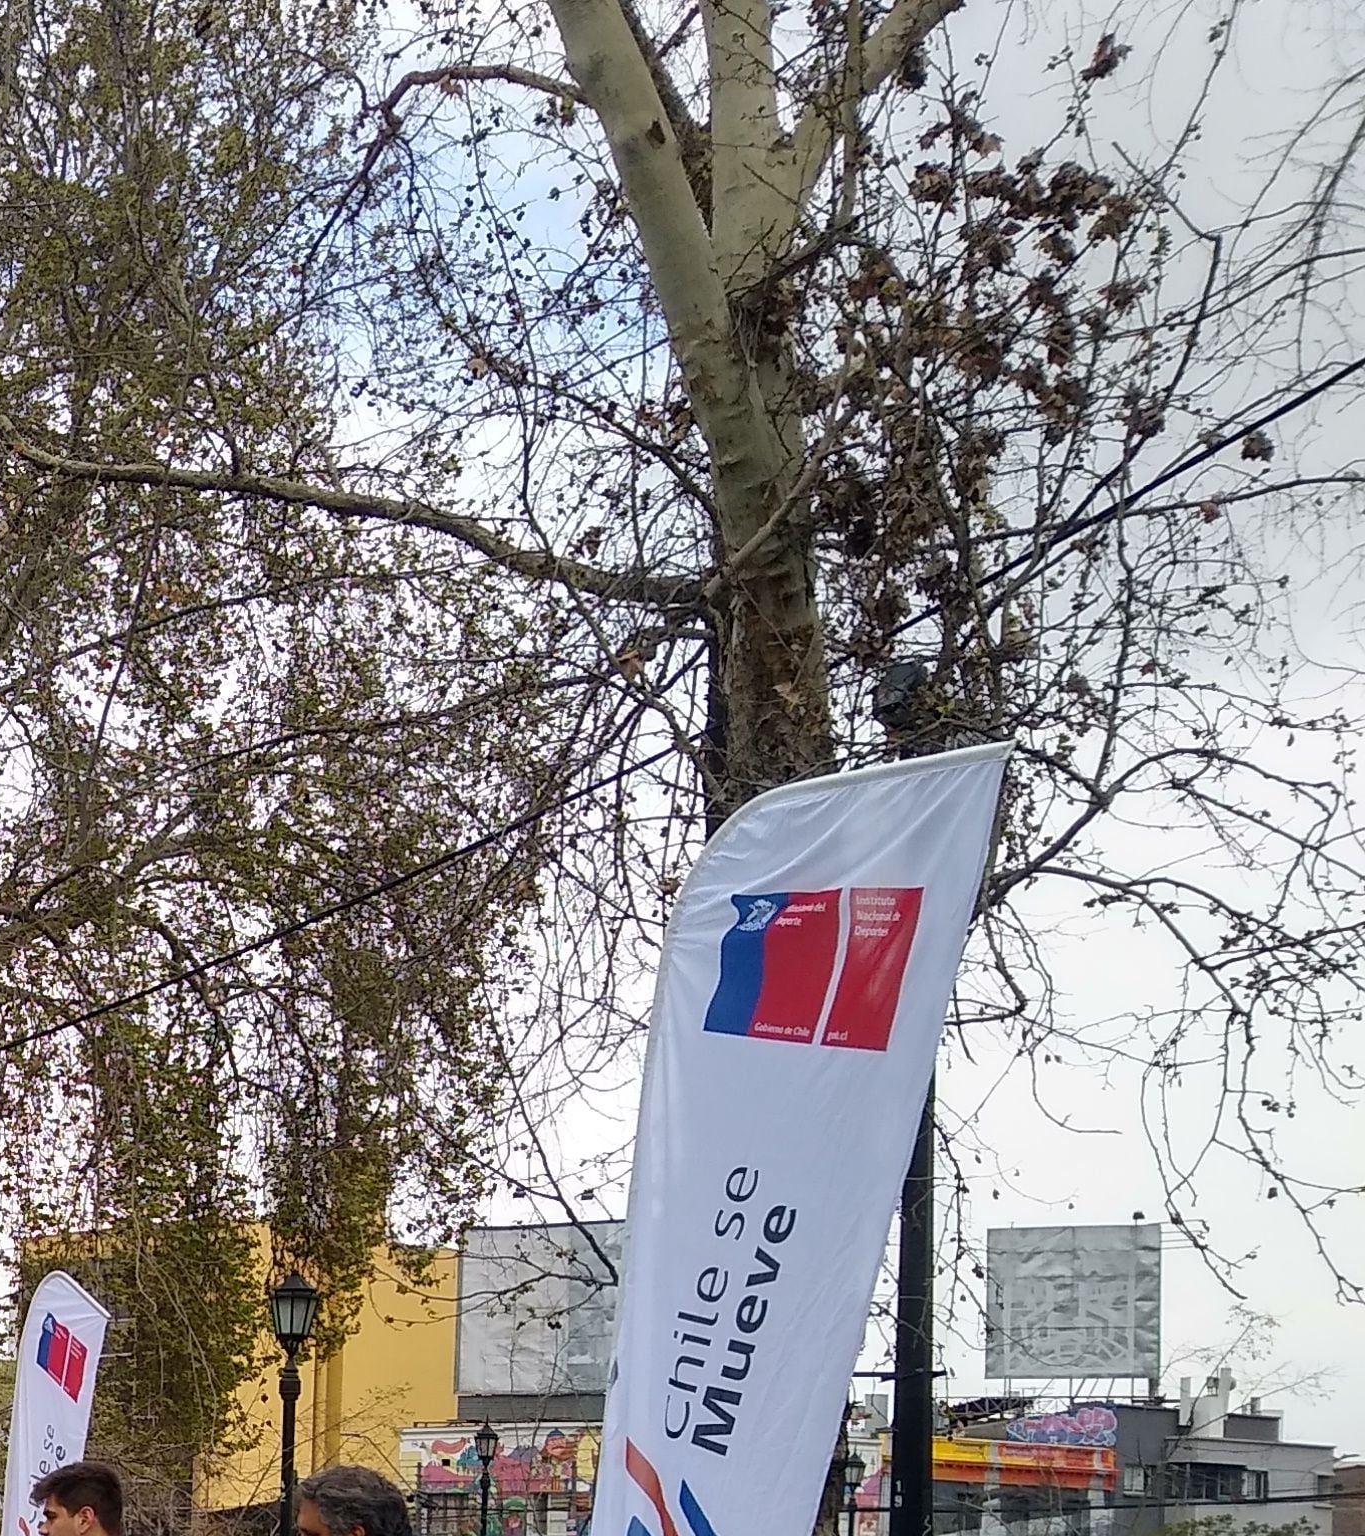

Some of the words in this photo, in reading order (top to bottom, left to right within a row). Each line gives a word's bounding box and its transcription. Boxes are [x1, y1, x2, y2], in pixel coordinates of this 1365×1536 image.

[793, 1023, 810, 1037] Chile
[664, 1266, 730, 1440] Chile
[714, 1165, 760, 1241] se
[690, 1204, 798, 1457] Mueve
[43, 1424, 55, 1454] se
